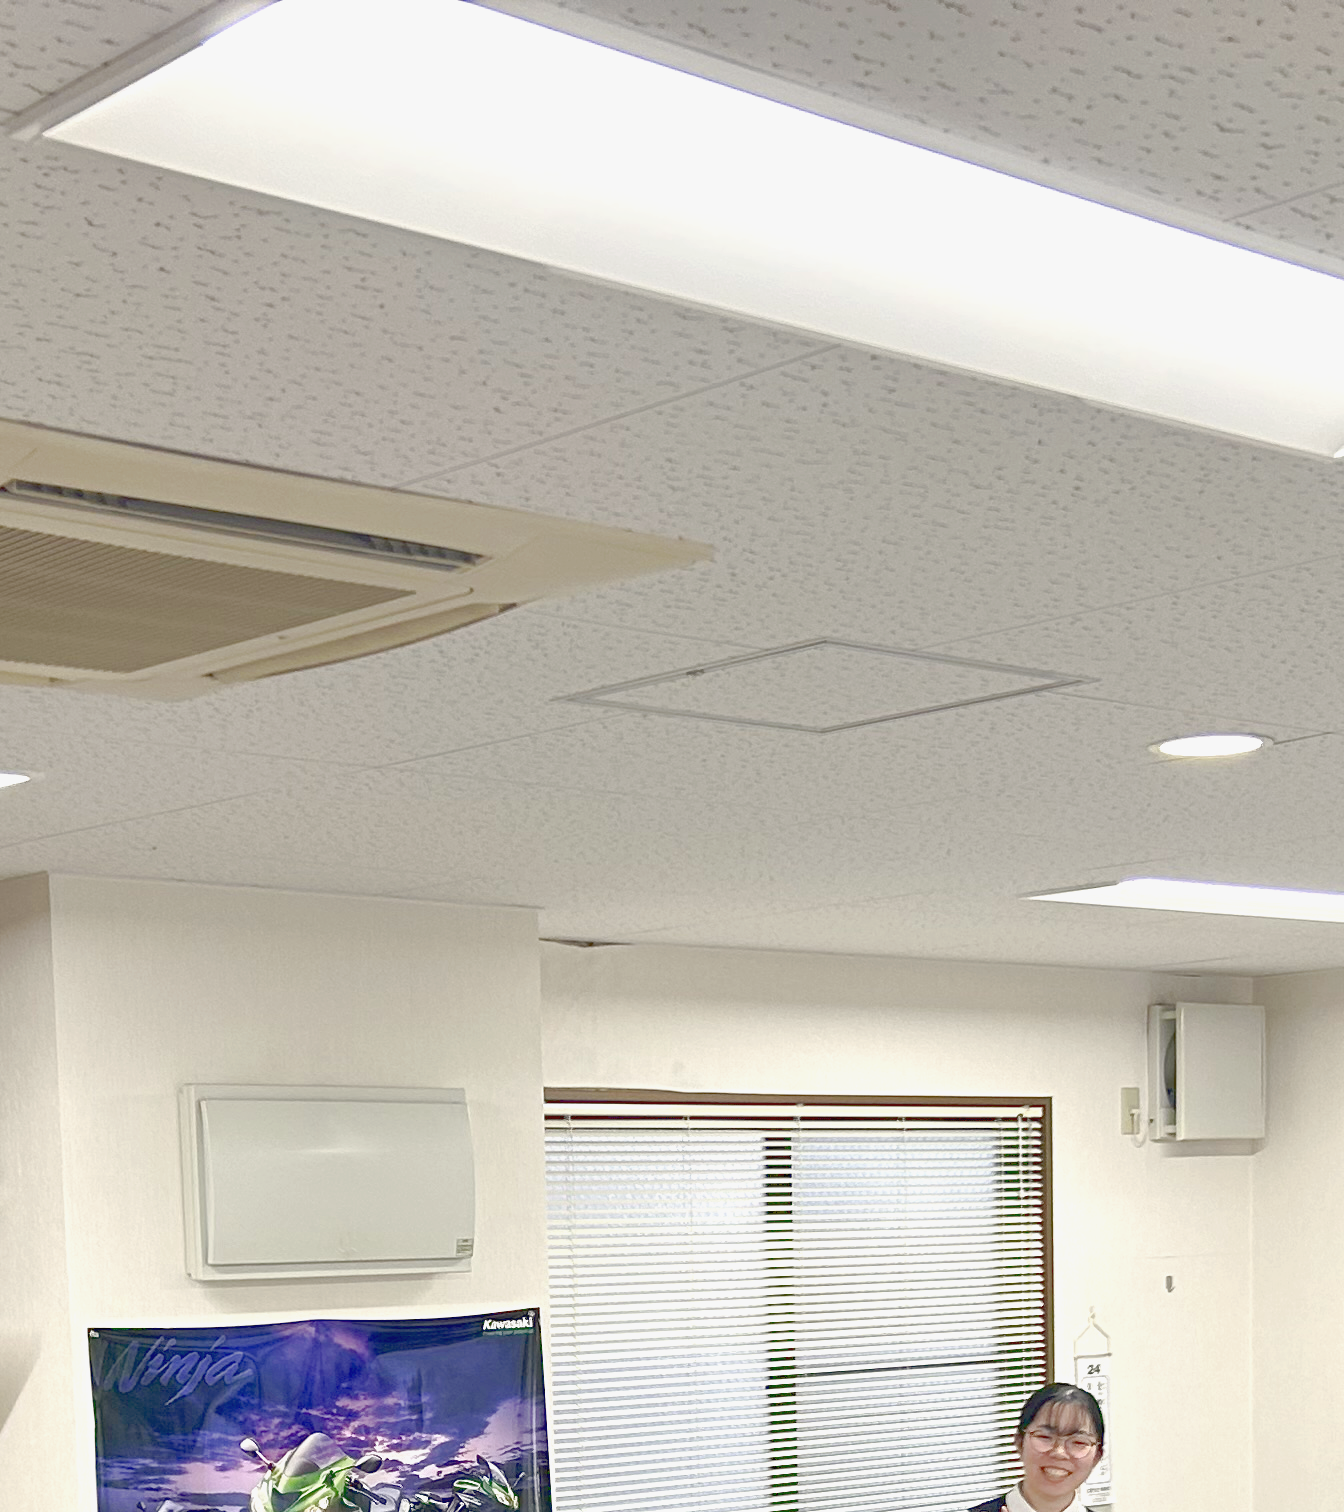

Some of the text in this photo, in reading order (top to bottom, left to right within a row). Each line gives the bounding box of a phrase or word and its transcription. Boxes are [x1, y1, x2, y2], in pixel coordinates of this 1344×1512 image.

[483, 1316, 533, 1330] Kawasaki
[103, 1335, 254, 1406] Ninja
[1087, 1364, 1101, 1375] 24
